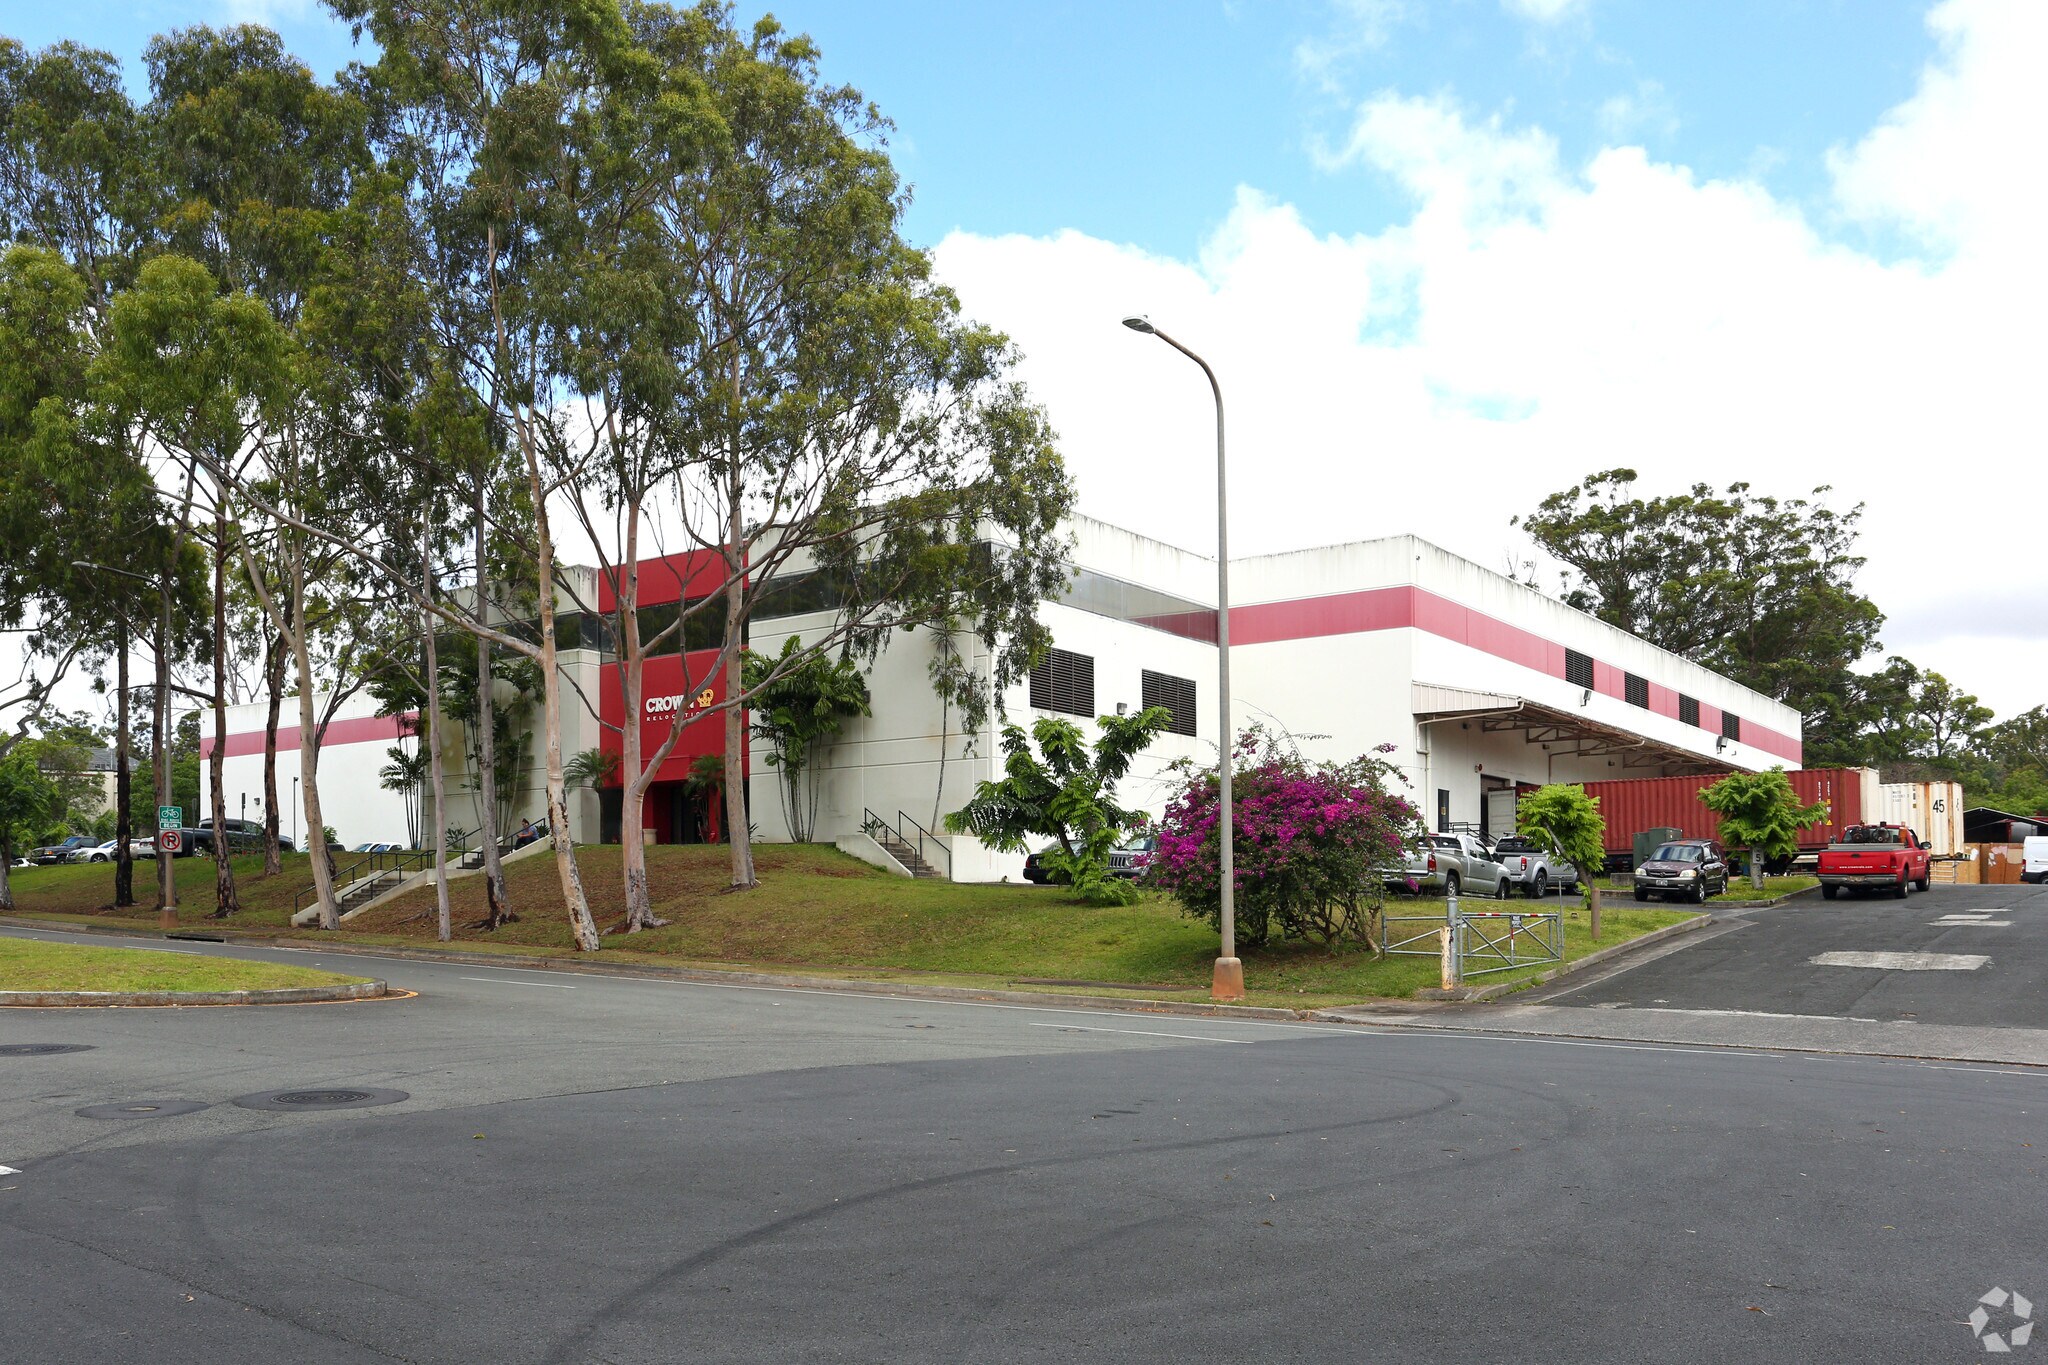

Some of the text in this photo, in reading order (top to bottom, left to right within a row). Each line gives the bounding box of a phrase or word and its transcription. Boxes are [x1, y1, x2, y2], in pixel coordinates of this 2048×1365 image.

[646, 711, 714, 722] RELOCTIO
[1932, 799, 1945, 813] 45
[1756, 853, 1761, 862] 5
